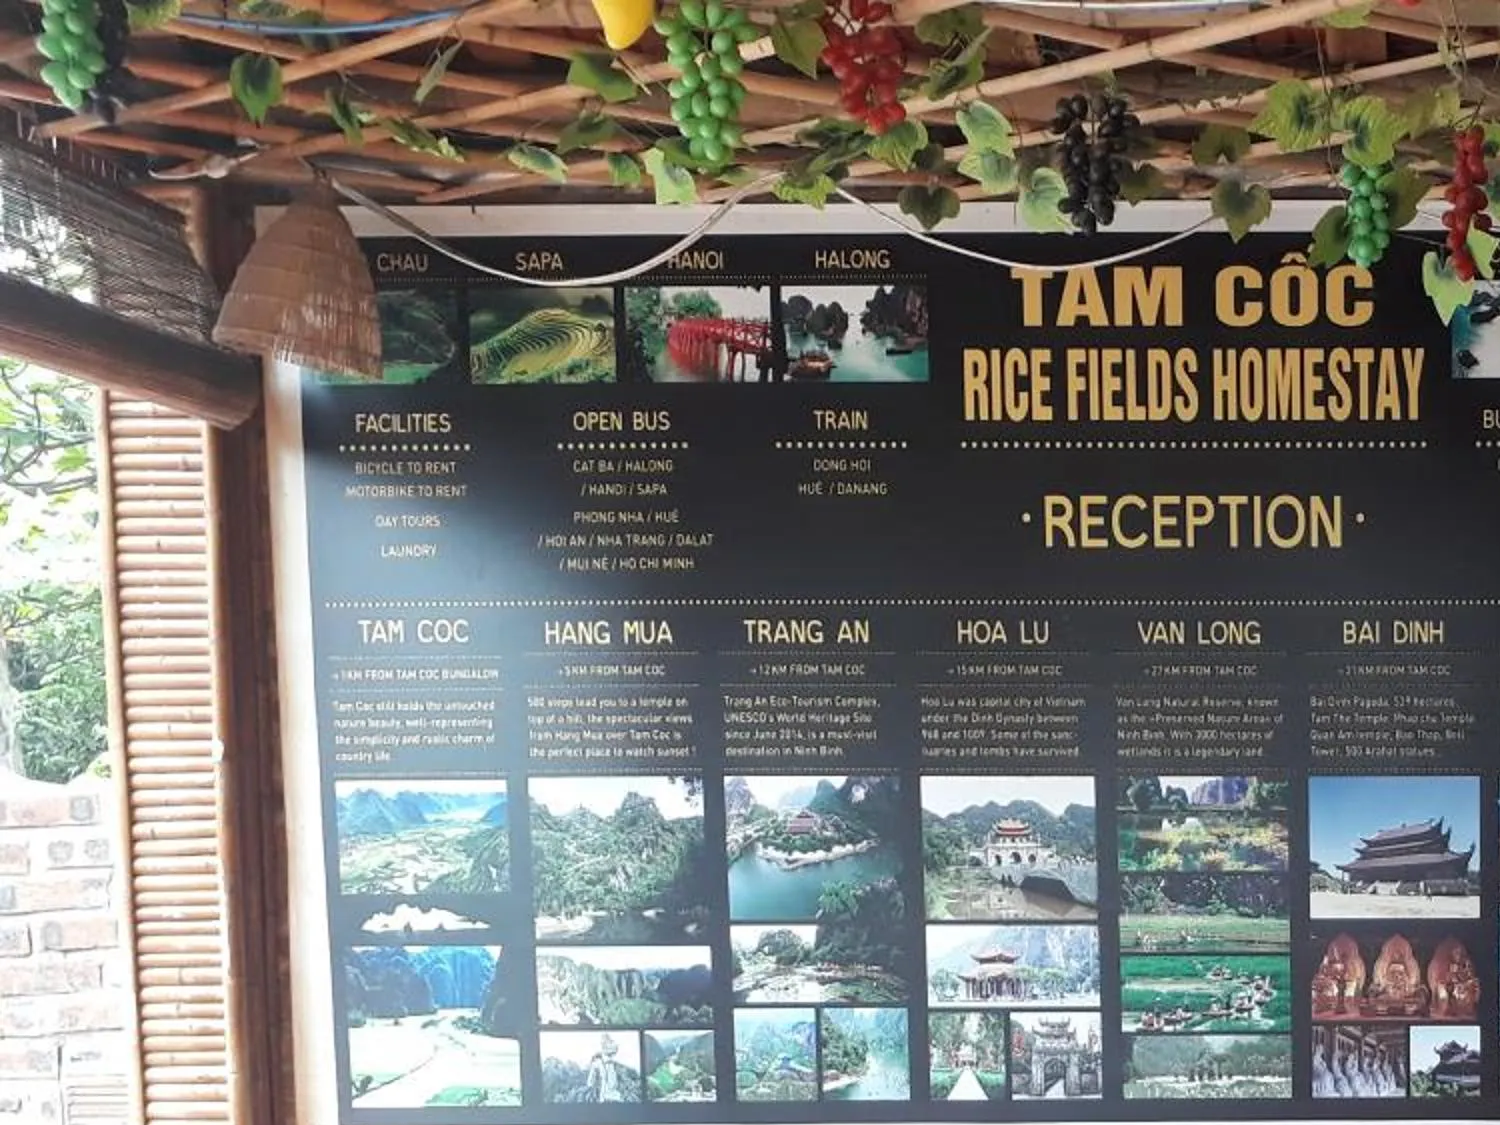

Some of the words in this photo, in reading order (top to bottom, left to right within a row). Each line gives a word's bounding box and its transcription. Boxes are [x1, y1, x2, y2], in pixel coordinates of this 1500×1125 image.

[377, 253, 429, 272] CHAU
[515, 252, 564, 271] SAPA
[668, 250, 723, 269] HANOI
[816, 250, 890, 268] HALONG
[1011, 264, 1184, 327] TAM
[964, 348, 1052, 422] RICE
[1067, 348, 1198, 421] FIELDS
[1213, 348, 1424, 421] HOMESTAY
[356, 414, 451, 432] FACILITIES
[574, 412, 622, 430] OPEN
[633, 411, 670, 430] BUS
[814, 410, 867, 429] TRAIN
[355, 461, 403, 475] BICYCLE
[407, 461, 422, 475] TO
[425, 461, 457, 474] RENT
[573, 459, 594, 473] CAT
[626, 459, 673, 472] HALONG
[346, 485, 415, 497] MOTORBIKE
[419, 485, 433, 497] TO
[435, 485, 468, 497] RENT
[638, 483, 668, 496] SAPA
[837, 482, 888, 495] DANANG
[574, 511, 616, 523] PHONG
[619, 511, 644, 523] NHA
[1044, 495, 1342, 548] RECEPTION
[626, 534, 666, 547] TRANG
[676, 534, 714, 547] DALAT
[381, 543, 437, 558] LAUNDRY
[358, 620, 404, 643] TAM
[418, 619, 468, 642] COC
[545, 621, 610, 646] HANG
[624, 621, 672, 643] MUA
[744, 620, 823, 643] TRANG
[838, 620, 868, 643] AN
[958, 621, 1007, 643] HOA
[1021, 621, 1048, 644] LU
[1138, 622, 1184, 644] VAN
[1198, 621, 1260, 644] LONG
[1344, 621, 1379, 644] BAI
[1394, 621, 1443, 643] DINH
